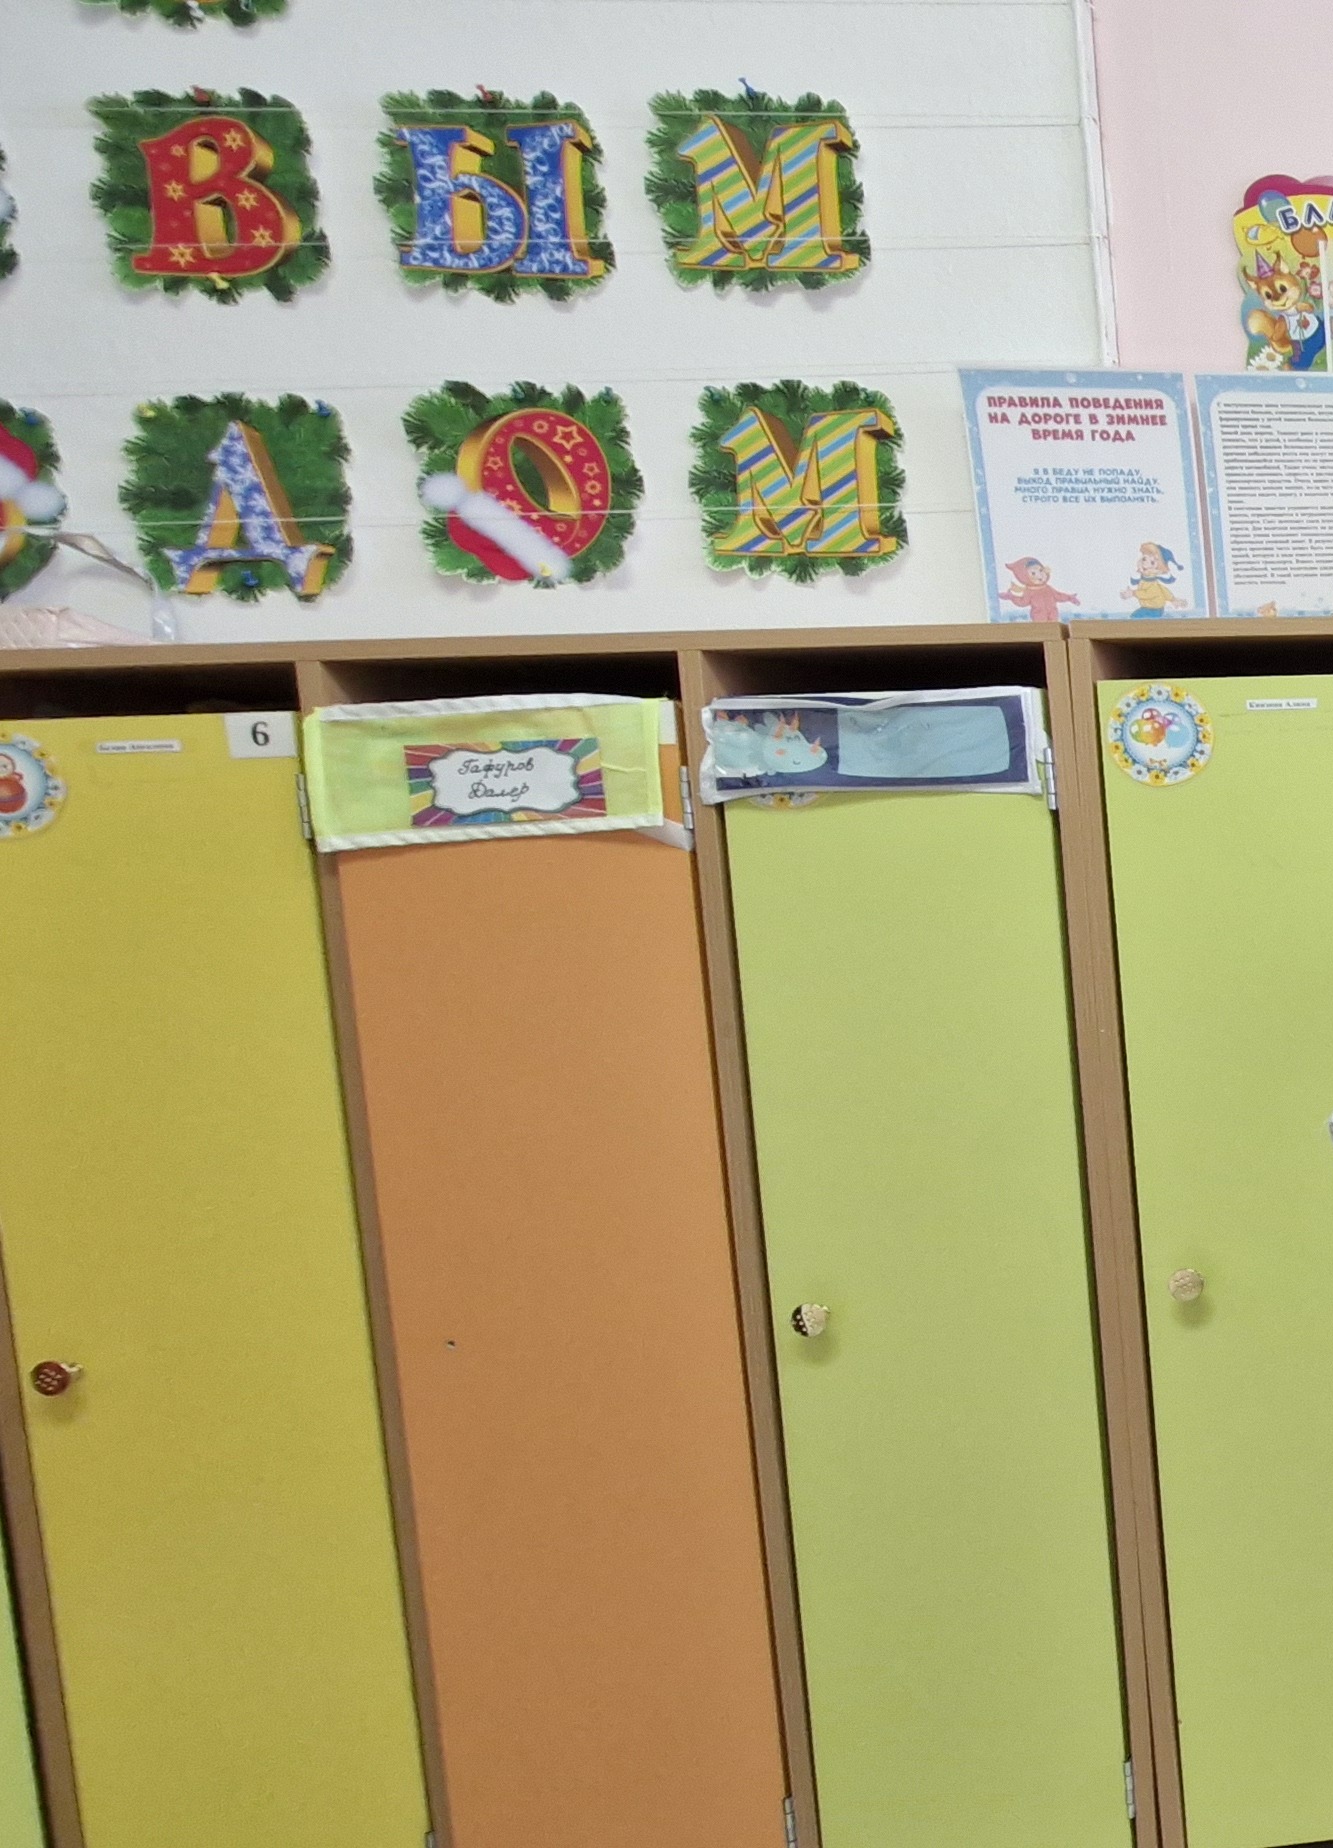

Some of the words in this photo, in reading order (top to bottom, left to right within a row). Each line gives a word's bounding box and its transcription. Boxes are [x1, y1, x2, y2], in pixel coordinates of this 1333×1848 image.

[987, 396, 1063, 409] ПРАВИЛА
[1068, 396, 1164, 410] ПОВЕДЕНИЯ
[987, 412, 1010, 424] НА
[1018, 413, 1082, 426] ДОРОГЕ
[1089, 414, 1099, 425] В
[1106, 414, 1168, 426] ЗИМНЕЕ
[1031, 428, 1084, 441] ВРЕМЯ
[1091, 429, 1136, 442] ГОДА
[1052, 468, 1079, 476] БЕДУ
[1017, 477, 1052, 486] ВЫХОД
[1055, 477, 1120, 485] ПРАВИЛЬНЫЙ
[1014, 486, 1048, 494] МНОГО
[1093, 486, 1127, 494] НУЖНО
[1022, 495, 1059, 503] СТРОГО
[1062, 495, 1080, 503] ВСЕ
[250, 720, 270, 746] 6
[457, 757, 534, 779] Гафуров
[468, 779, 530, 803] Далер
